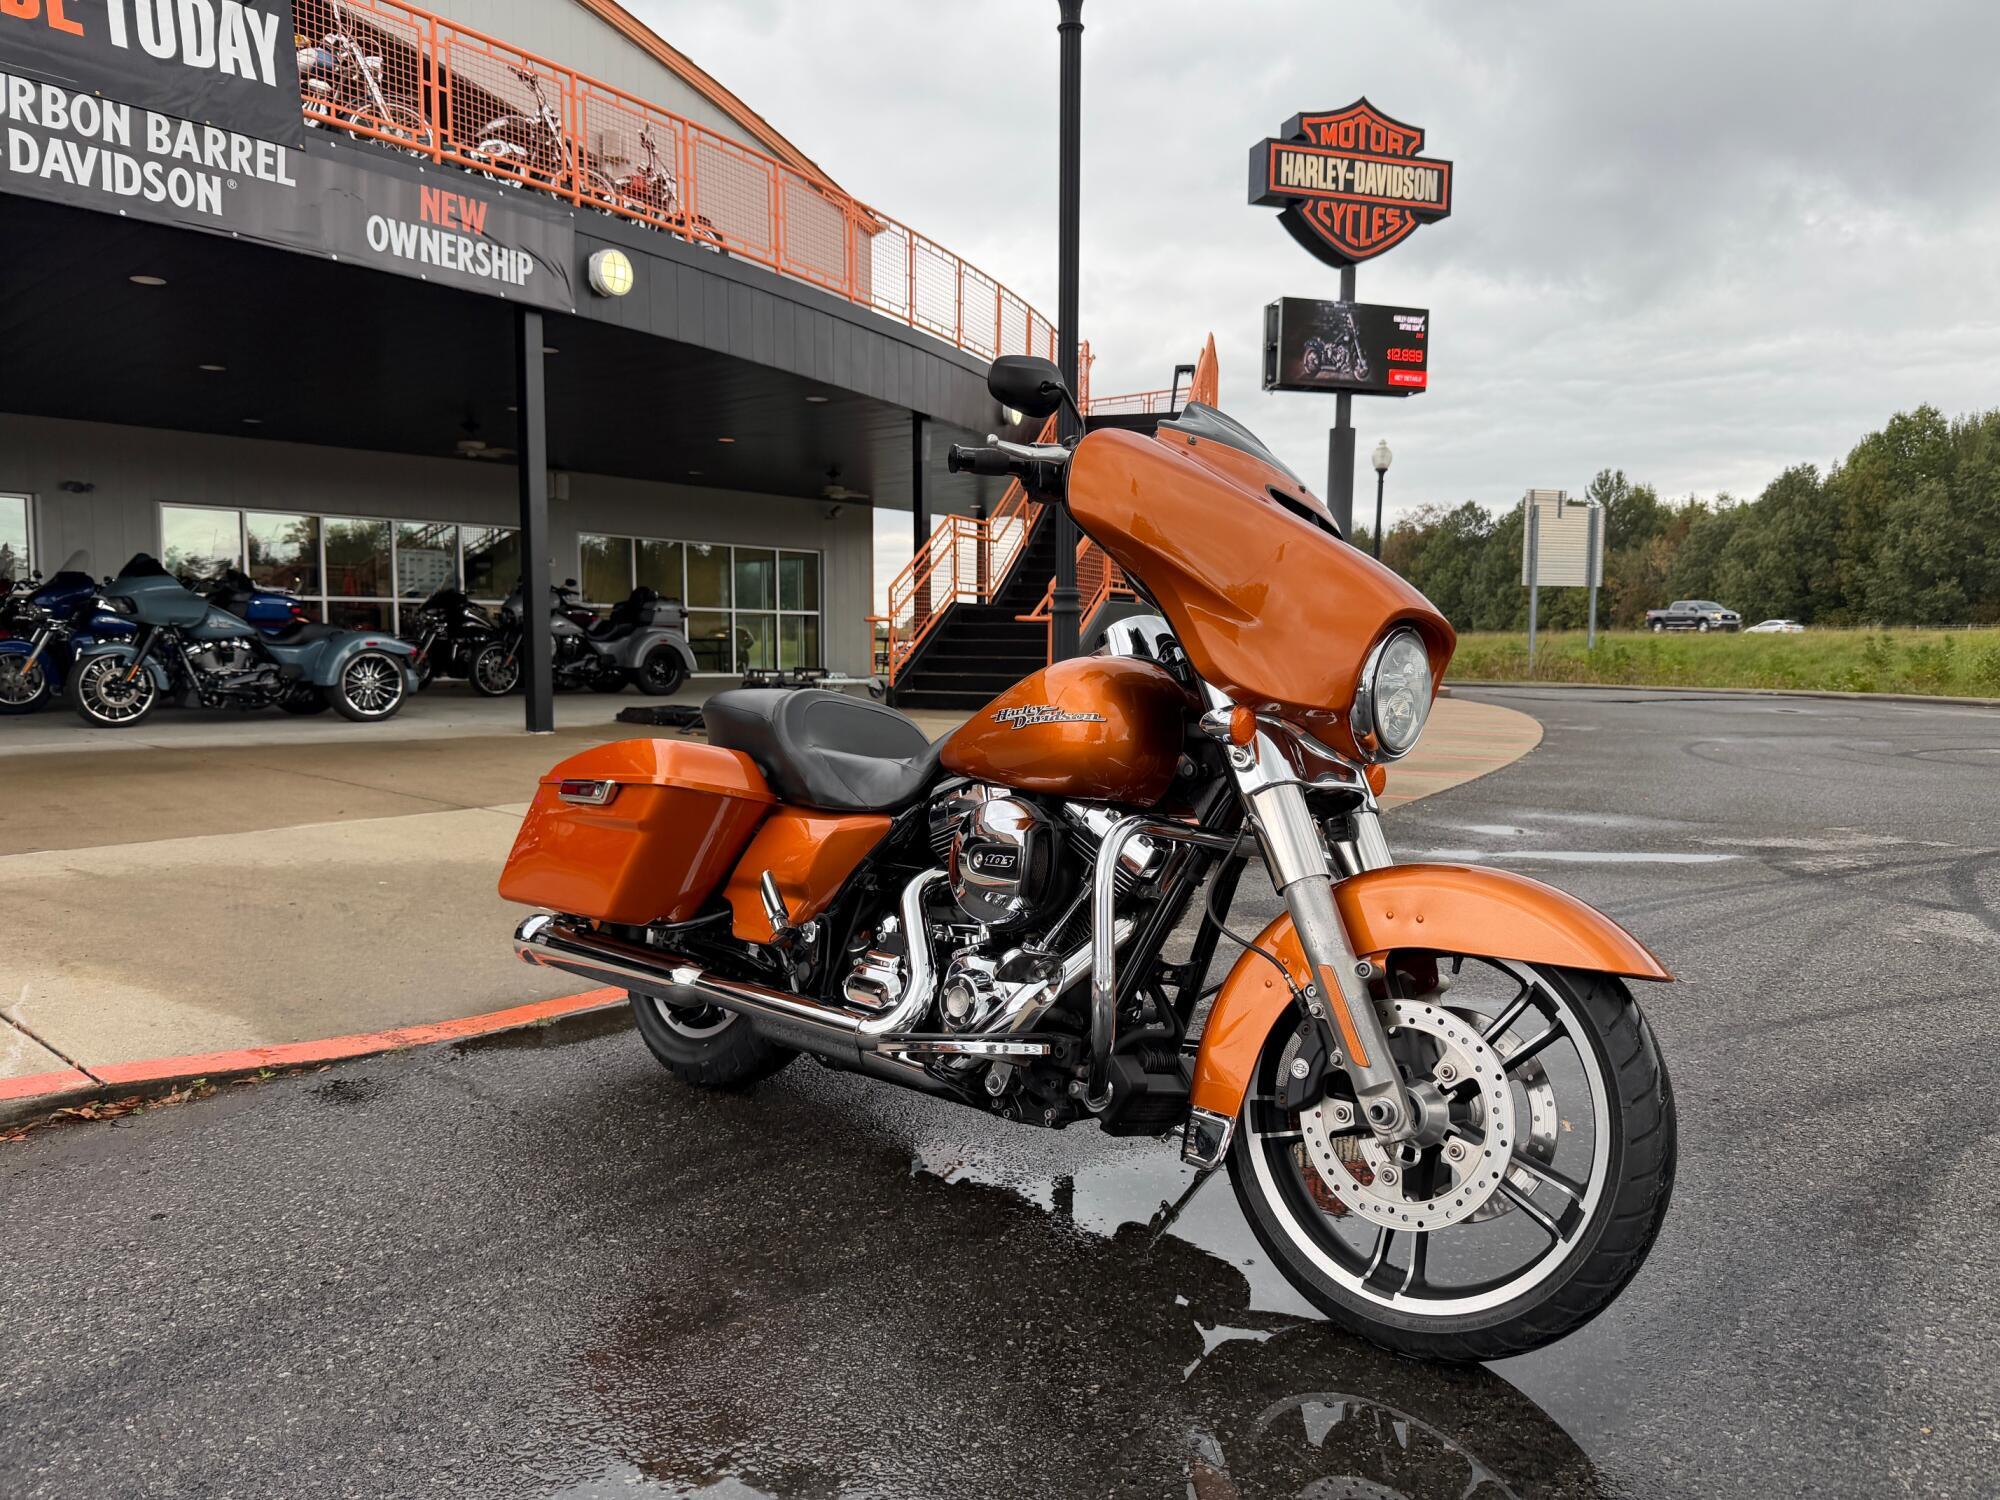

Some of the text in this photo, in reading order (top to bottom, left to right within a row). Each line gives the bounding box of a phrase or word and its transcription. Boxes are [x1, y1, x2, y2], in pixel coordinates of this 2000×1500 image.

[0, 73, 296, 188] RBON BARREL
[1320, 114, 1404, 156] MOTOR
[1280, 151, 1438, 202] HARLEY-DAVIDSON
[420, 185, 488, 236] NEW
[1317, 200, 1402, 248] CYCLES
[366, 215, 534, 286] OWNERSHIP
[984, 853, 1016, 868] 103
